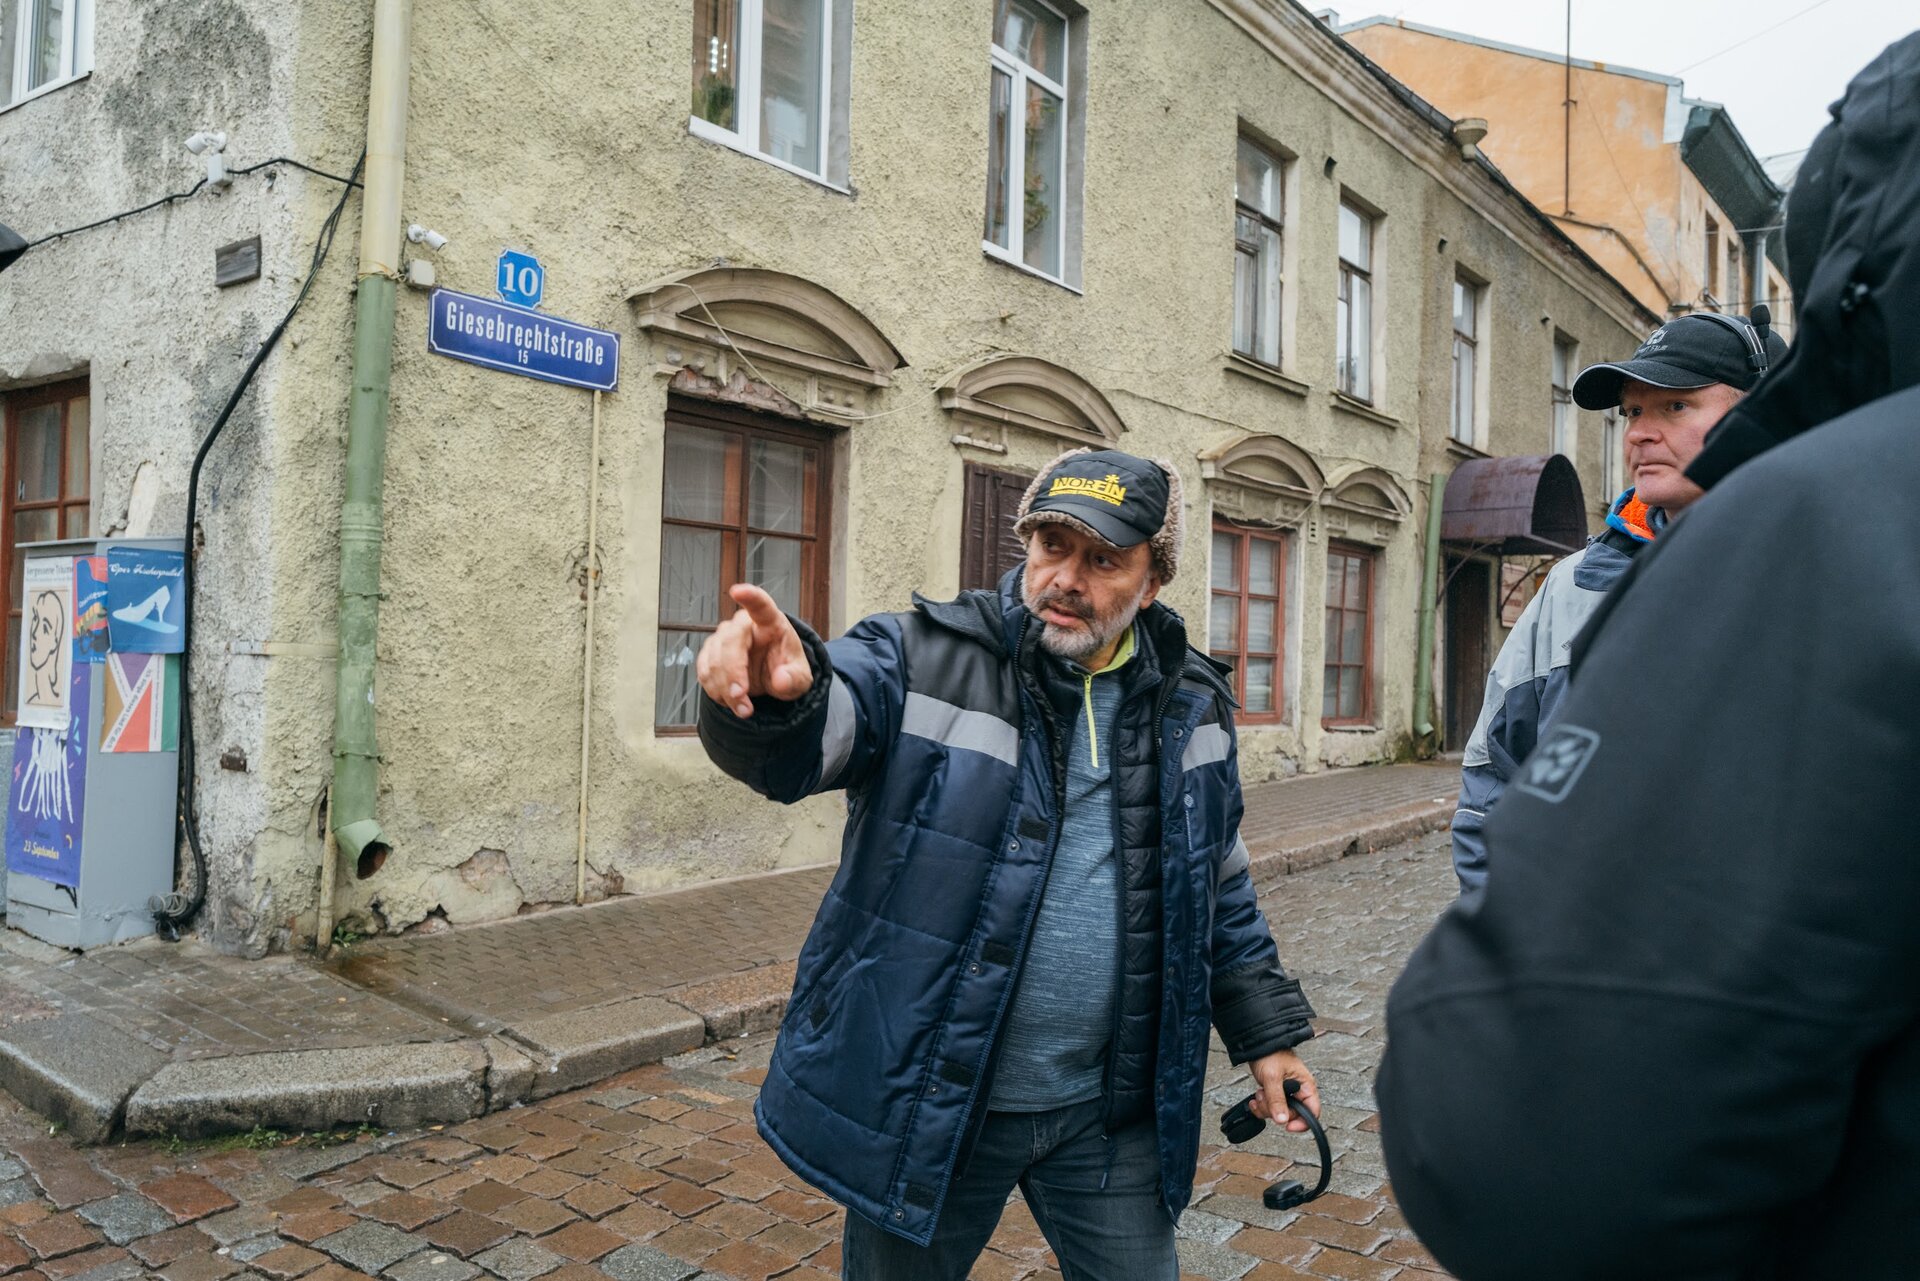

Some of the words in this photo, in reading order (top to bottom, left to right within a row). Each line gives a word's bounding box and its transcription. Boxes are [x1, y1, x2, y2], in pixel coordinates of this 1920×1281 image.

[503, 262, 539, 297] 10
[446, 301, 604, 366] Giesebrechtstraße
[518, 349, 529, 365] 15
[109, 563, 131, 577] Oper
[31, 841, 60, 860] September
